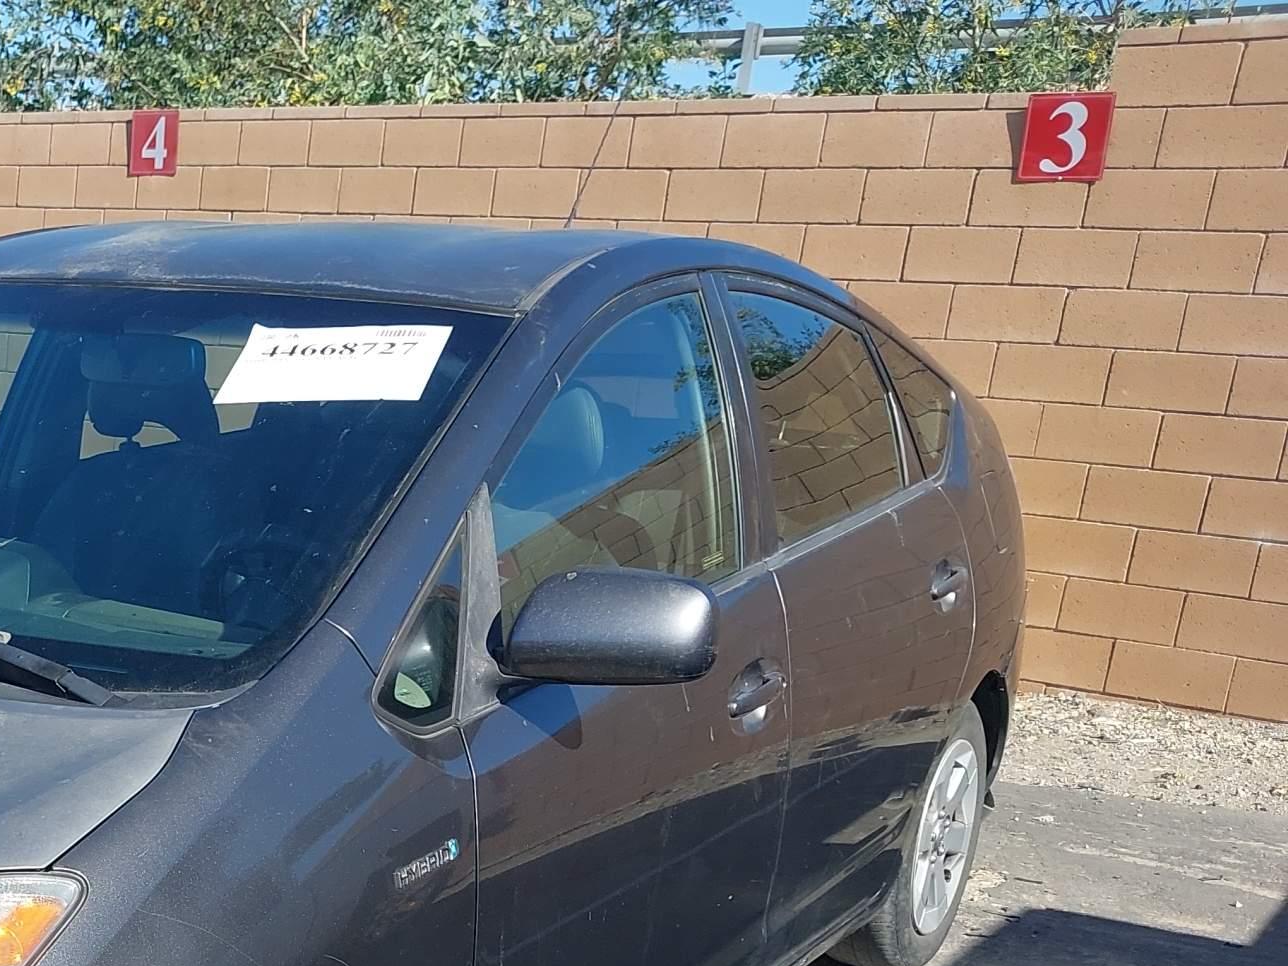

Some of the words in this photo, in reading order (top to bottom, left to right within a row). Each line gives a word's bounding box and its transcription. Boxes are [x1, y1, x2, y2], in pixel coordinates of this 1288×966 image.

[141, 116, 168, 170] 4
[1039, 101, 1088, 173] 3
[261, 342, 419, 357] 44668727
